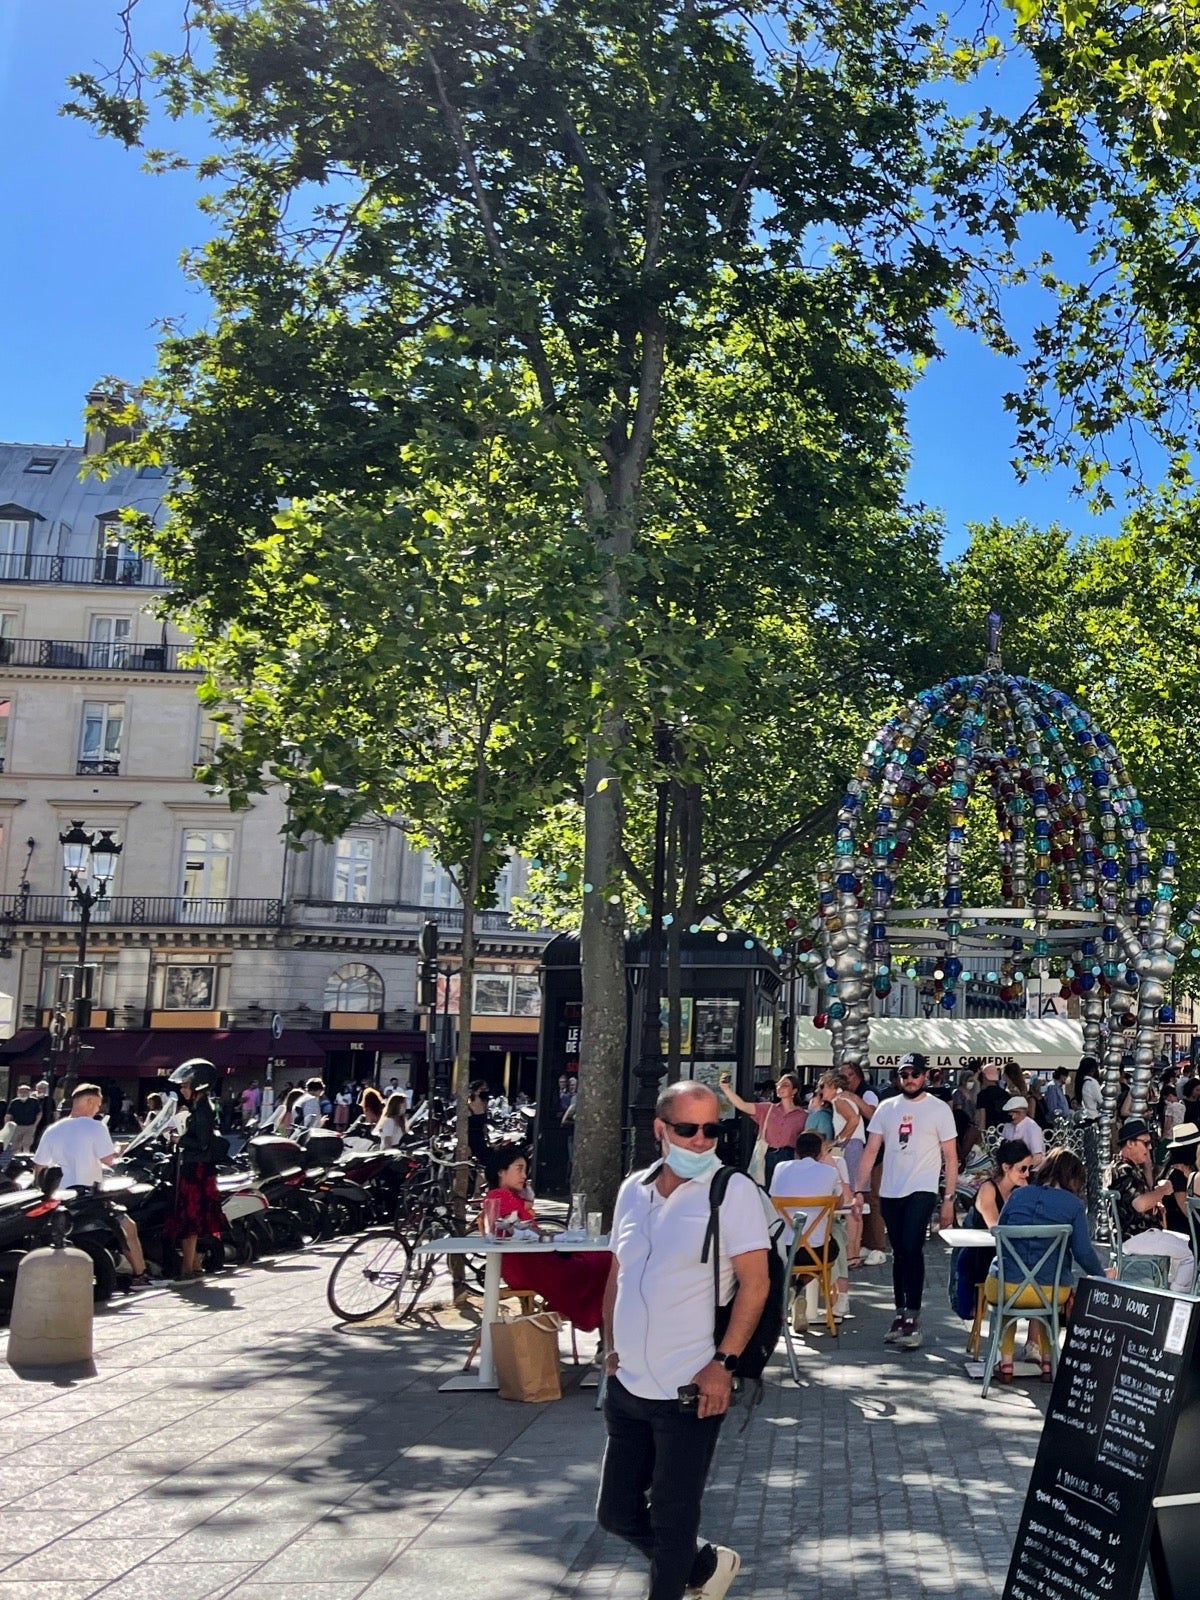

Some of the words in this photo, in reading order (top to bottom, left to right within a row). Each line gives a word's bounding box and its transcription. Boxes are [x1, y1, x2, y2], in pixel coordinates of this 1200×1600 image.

[568, 1029, 579, 1040] LE
[566, 1041, 577, 1053] DE
[937, 1056, 952, 1066] LA
[1112, 1294, 1122, 1309] DU
